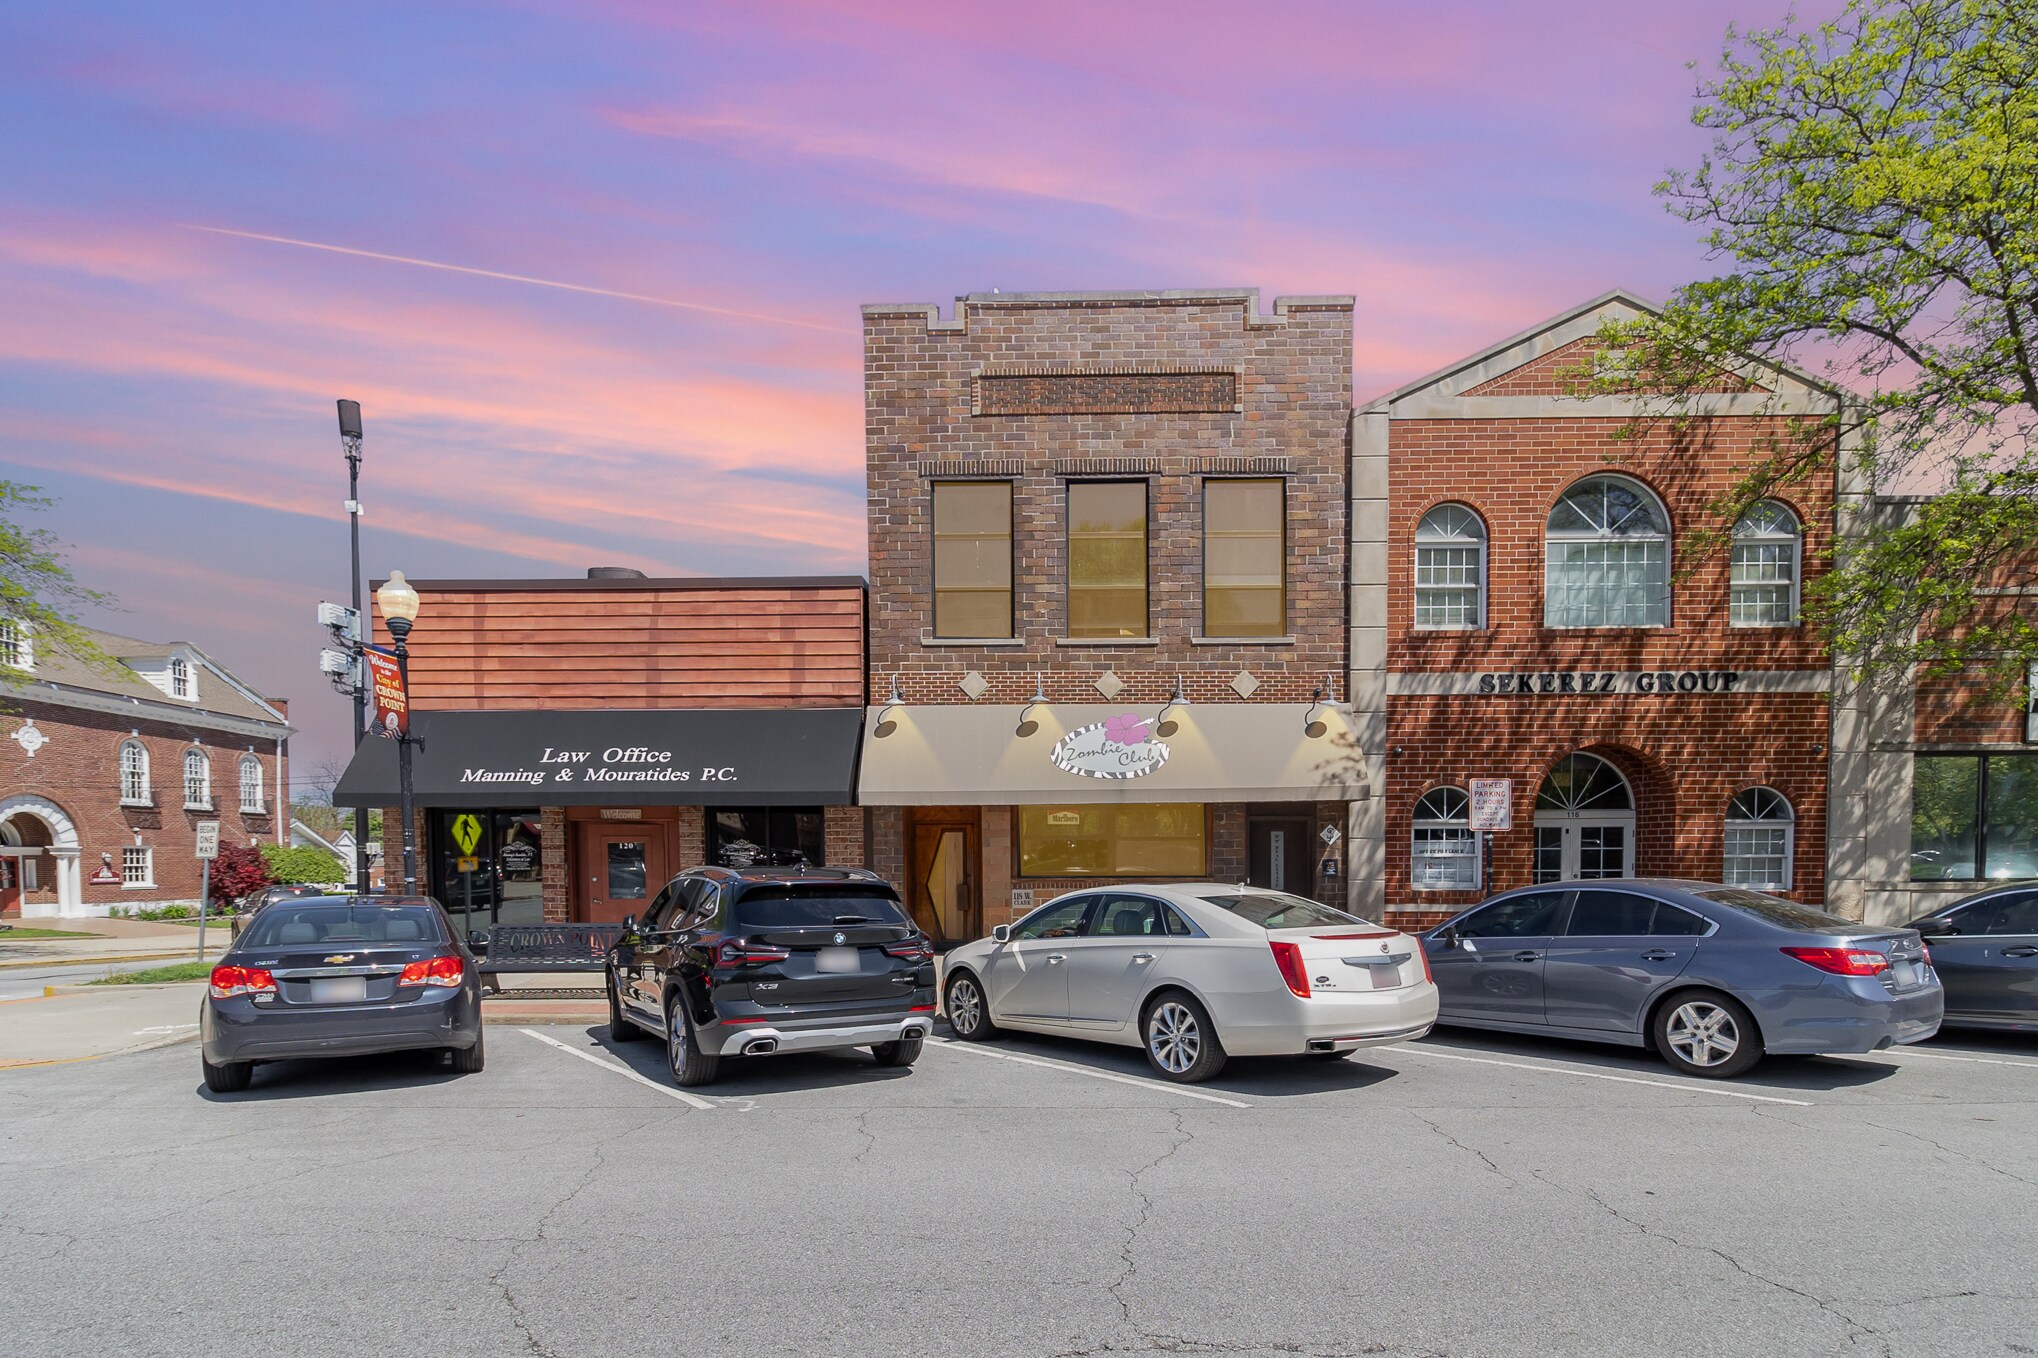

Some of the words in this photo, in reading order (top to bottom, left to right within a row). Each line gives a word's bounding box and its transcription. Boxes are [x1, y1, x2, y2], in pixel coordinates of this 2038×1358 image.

[369, 655, 398, 671] Welcome
[376, 673, 391, 688] City
[392, 680, 400, 688] of
[1478, 673, 1617, 693] SEKEREZ
[1635, 672, 1739, 692] GROUP
[376, 685, 405, 702] CROWN
[380, 696, 405, 713] POINT
[540, 748, 591, 763] Law
[602, 747, 672, 763] Office
[1066, 742, 1124, 761] Zombie
[1118, 748, 1155, 766] Club
[460, 768, 546, 784] Manning
[554, 768, 574, 782] &
[583, 767, 691, 782] Mouratides
[699, 767, 738, 781] P.C.
[602, 809, 641, 819] Welcome
[1052, 813, 1078, 823] Marlboro
[199, 825, 216, 833] BEGIN
[200, 835, 214, 843] ONE
[510, 930, 565, 953] CROWN
[569, 930, 616, 951] POINT
